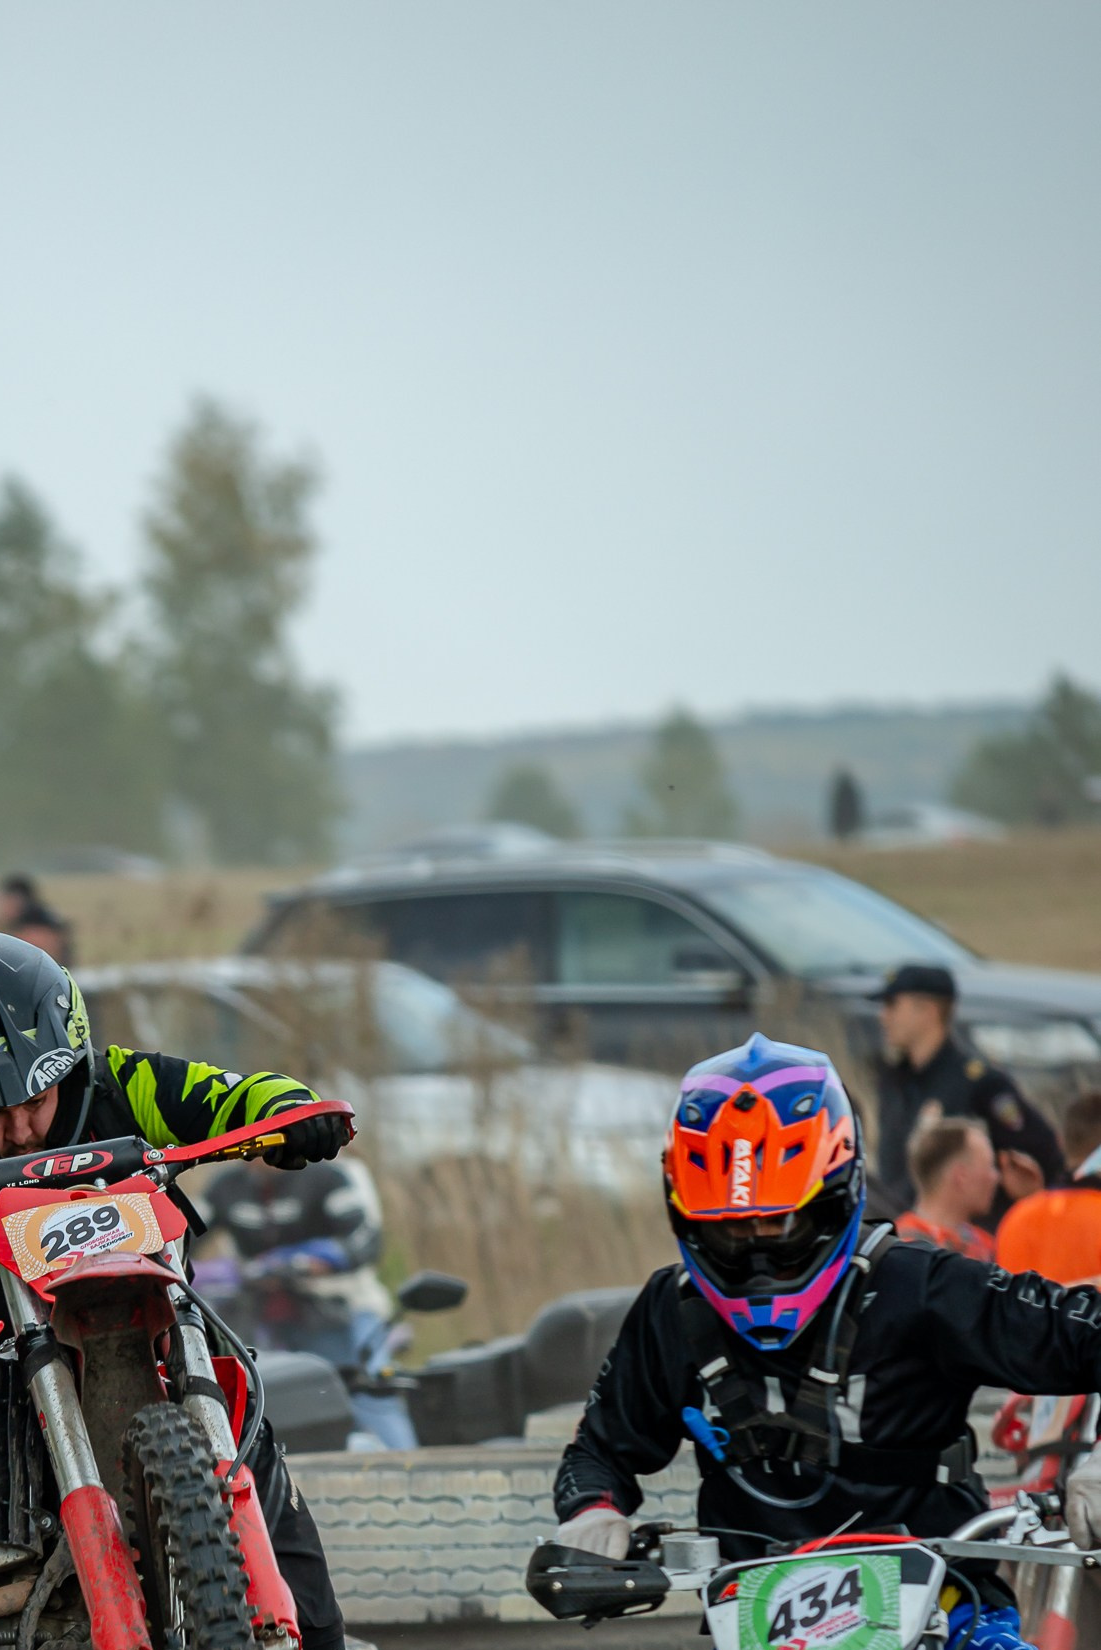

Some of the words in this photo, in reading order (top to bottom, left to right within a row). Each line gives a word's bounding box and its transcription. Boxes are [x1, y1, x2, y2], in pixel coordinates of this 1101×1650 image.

[34, 1054, 74, 1091] Airoh
[19, 1178, 40, 1187] LONG
[731, 1138, 753, 1207] ATAKI
[40, 1205, 121, 1264] 289
[767, 1568, 865, 1643] 434
